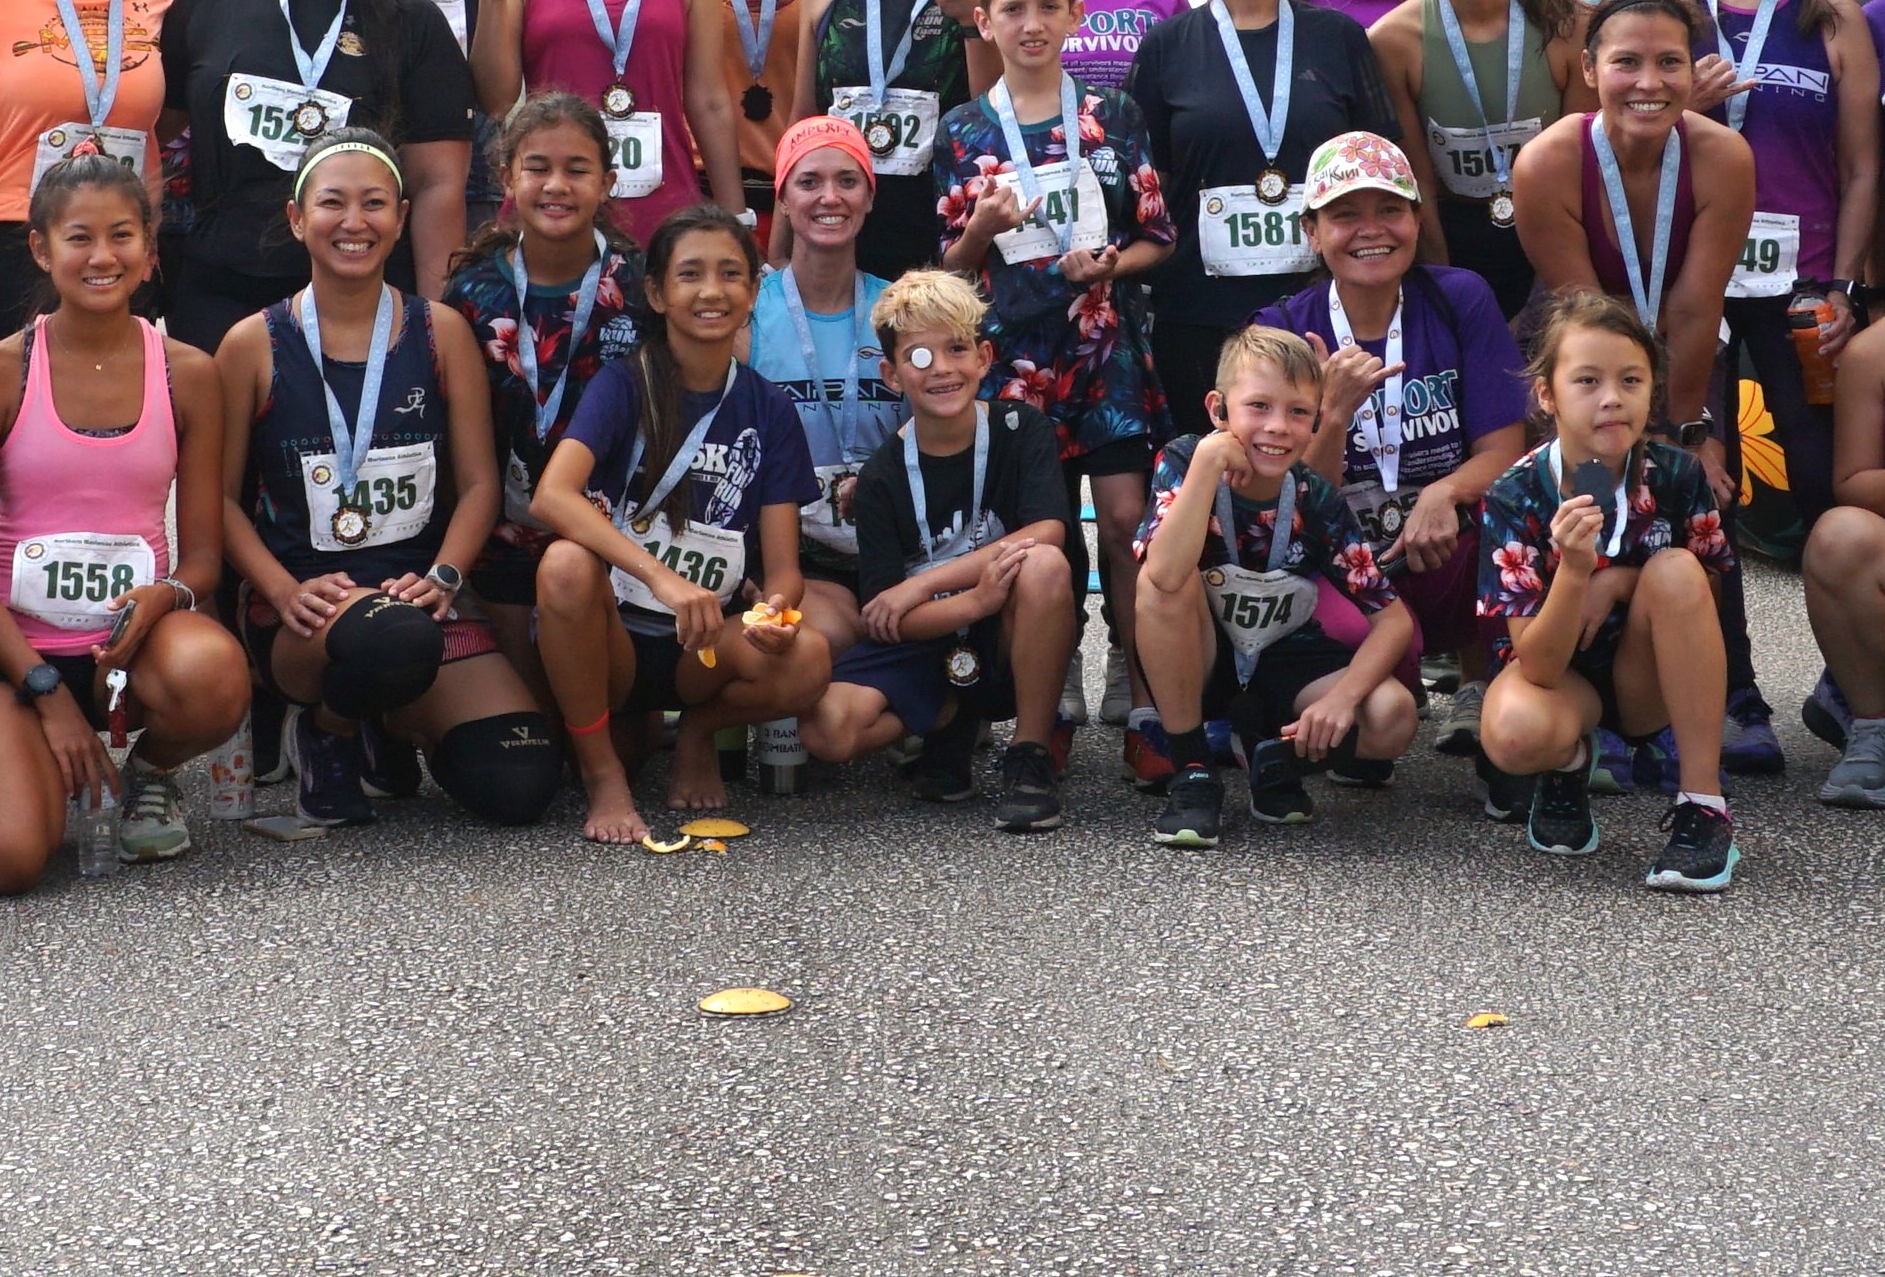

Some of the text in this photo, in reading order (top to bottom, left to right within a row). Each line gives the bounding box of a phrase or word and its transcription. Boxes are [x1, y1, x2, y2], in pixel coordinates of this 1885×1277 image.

[248, 103, 310, 145] 152
[1224, 211, 1301, 248] 1581
[332, 475, 417, 517] 1435
[714, 476, 744, 509] RUN
[42, 560, 135, 603] 1558
[1221, 591, 1296, 629] 1574
